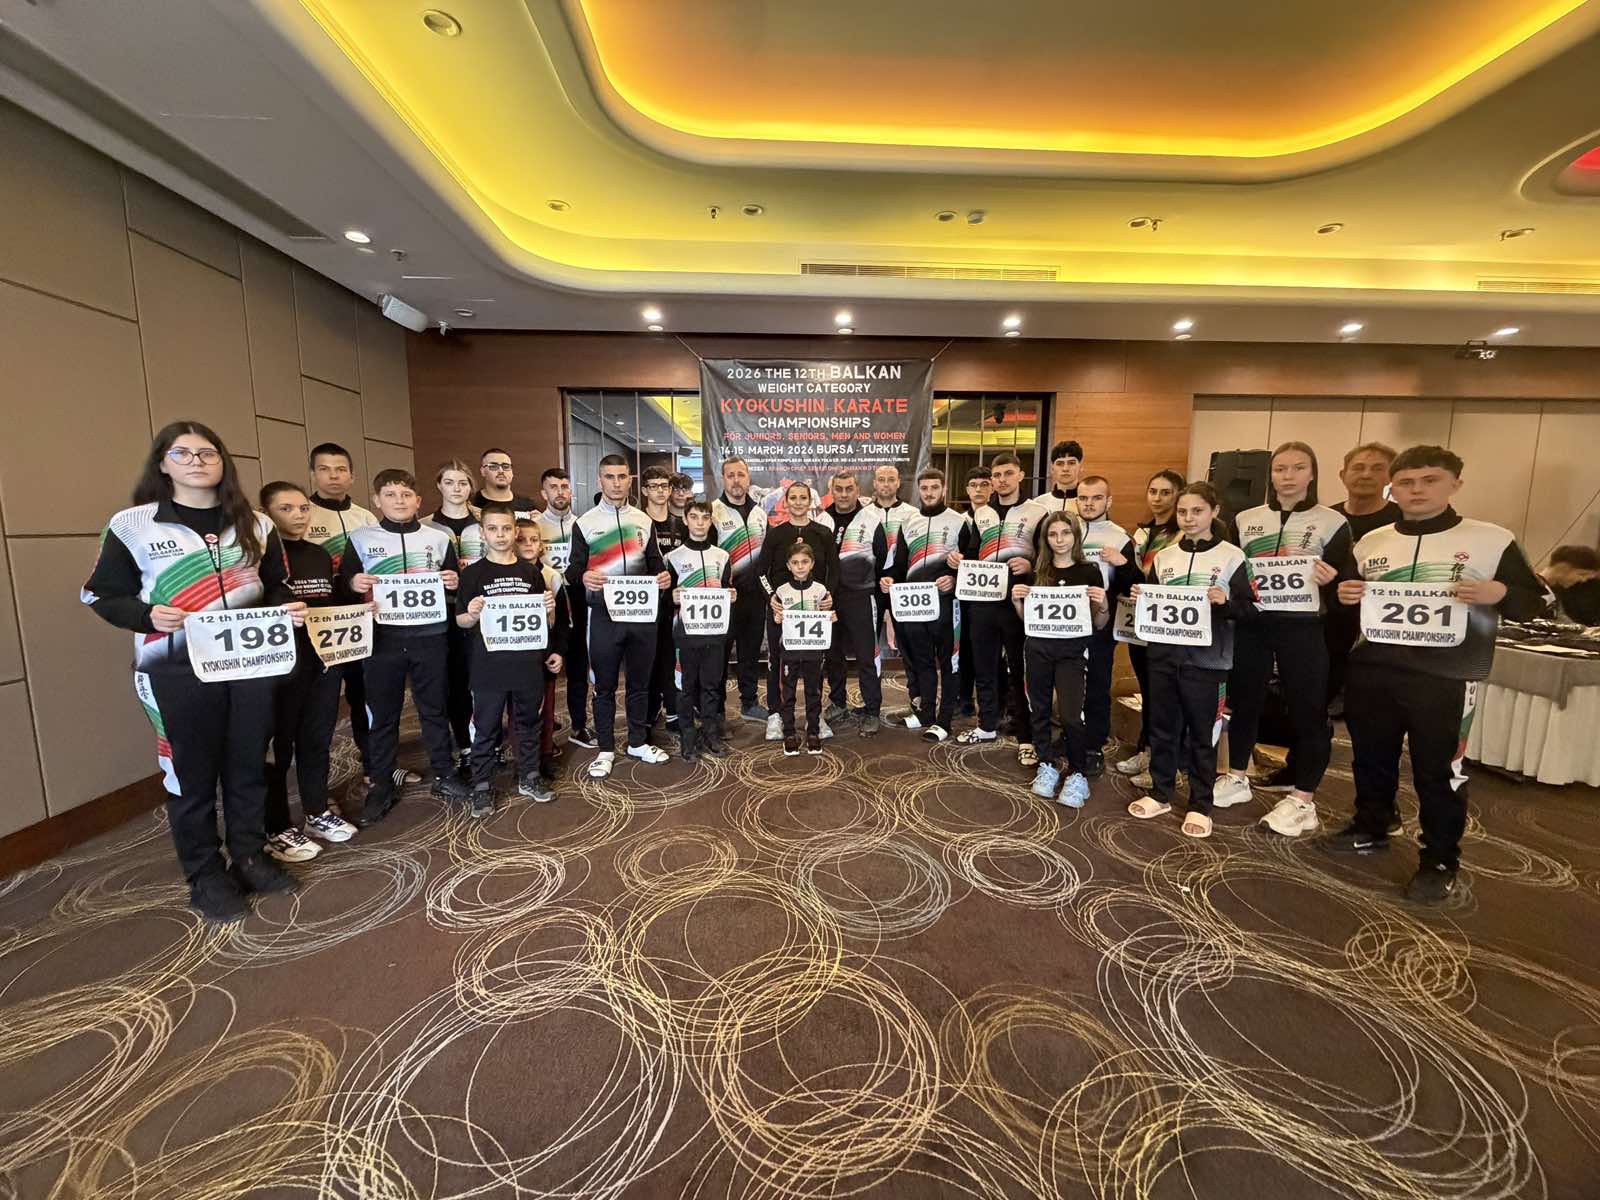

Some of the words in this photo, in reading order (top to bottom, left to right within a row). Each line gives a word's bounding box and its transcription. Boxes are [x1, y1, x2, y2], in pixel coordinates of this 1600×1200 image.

[727, 368, 761, 380] 2026
[765, 368, 791, 379] THE
[794, 368, 826, 379] 12TH
[830, 365, 901, 380] BALKAN
[758, 383, 803, 393] WEIGHT
[806, 383, 871, 393] CATEGORY
[720, 399, 825, 414] KYOKUSHIN
[834, 399, 908, 413] KARATE
[758, 417, 871, 428] CHAMPIONSHIPS
[723, 432, 741, 440] FOR
[831, 432, 850, 440] MEN
[853, 432, 870, 440] AND
[873, 432, 906, 440] WOMEN
[720, 446, 744, 455] 14-15
[748, 446, 784, 455] MARCH
[787, 446, 814, 455] 2026
[816, 444, 854, 454] BURSA
[861, 444, 909, 454] TURKIYE
[149, 540, 177, 551] IKO
[1268, 559, 1307, 567] BALKAN
[1368, 556, 1388, 567] IKO
[966, 573, 1000, 588] 304
[1255, 573, 1305, 591] 286
[386, 589, 437, 608] 188
[614, 590, 649, 605] 299
[900, 593, 931, 607] 308
[1166, 594, 1203, 602] BALKAN
[1371, 588, 1384, 596] 12
[1404, 590, 1458, 598] BALKAN
[198, 615, 215, 624] 12
[218, 614, 233, 622] th
[236, 609, 289, 621] BALKAN
[334, 611, 365, 621] BALKAN
[405, 611, 442, 620] CHAMPIONSHIPS
[687, 604, 722, 620] 110
[1034, 603, 1076, 620] 120
[1146, 603, 1199, 625] 130
[1381, 603, 1453, 627] 261
[496, 614, 542, 632] 159
[794, 620, 824, 638] 14
[1051, 624, 1083, 632] CHAMPIONSHIPS
[214, 623, 289, 652] 198
[317, 625, 362, 649] 278
[510, 635, 542, 644] CHAMPIONSHIPS
[1139, 625, 1165, 635] KYOKUSHIN
[1166, 628, 1203, 639] CHAMPIONSHIPS
[1366, 628, 1400, 640] KYOKUSHIN
[1402, 630, 1455, 643] CHAMPIONSHIPS
[335, 646, 368, 660] CHAMPIONSHIPS
[201, 657, 241, 673] KYOKUSHIN
[242, 650, 295, 669] CHAMPIONSHIPS
